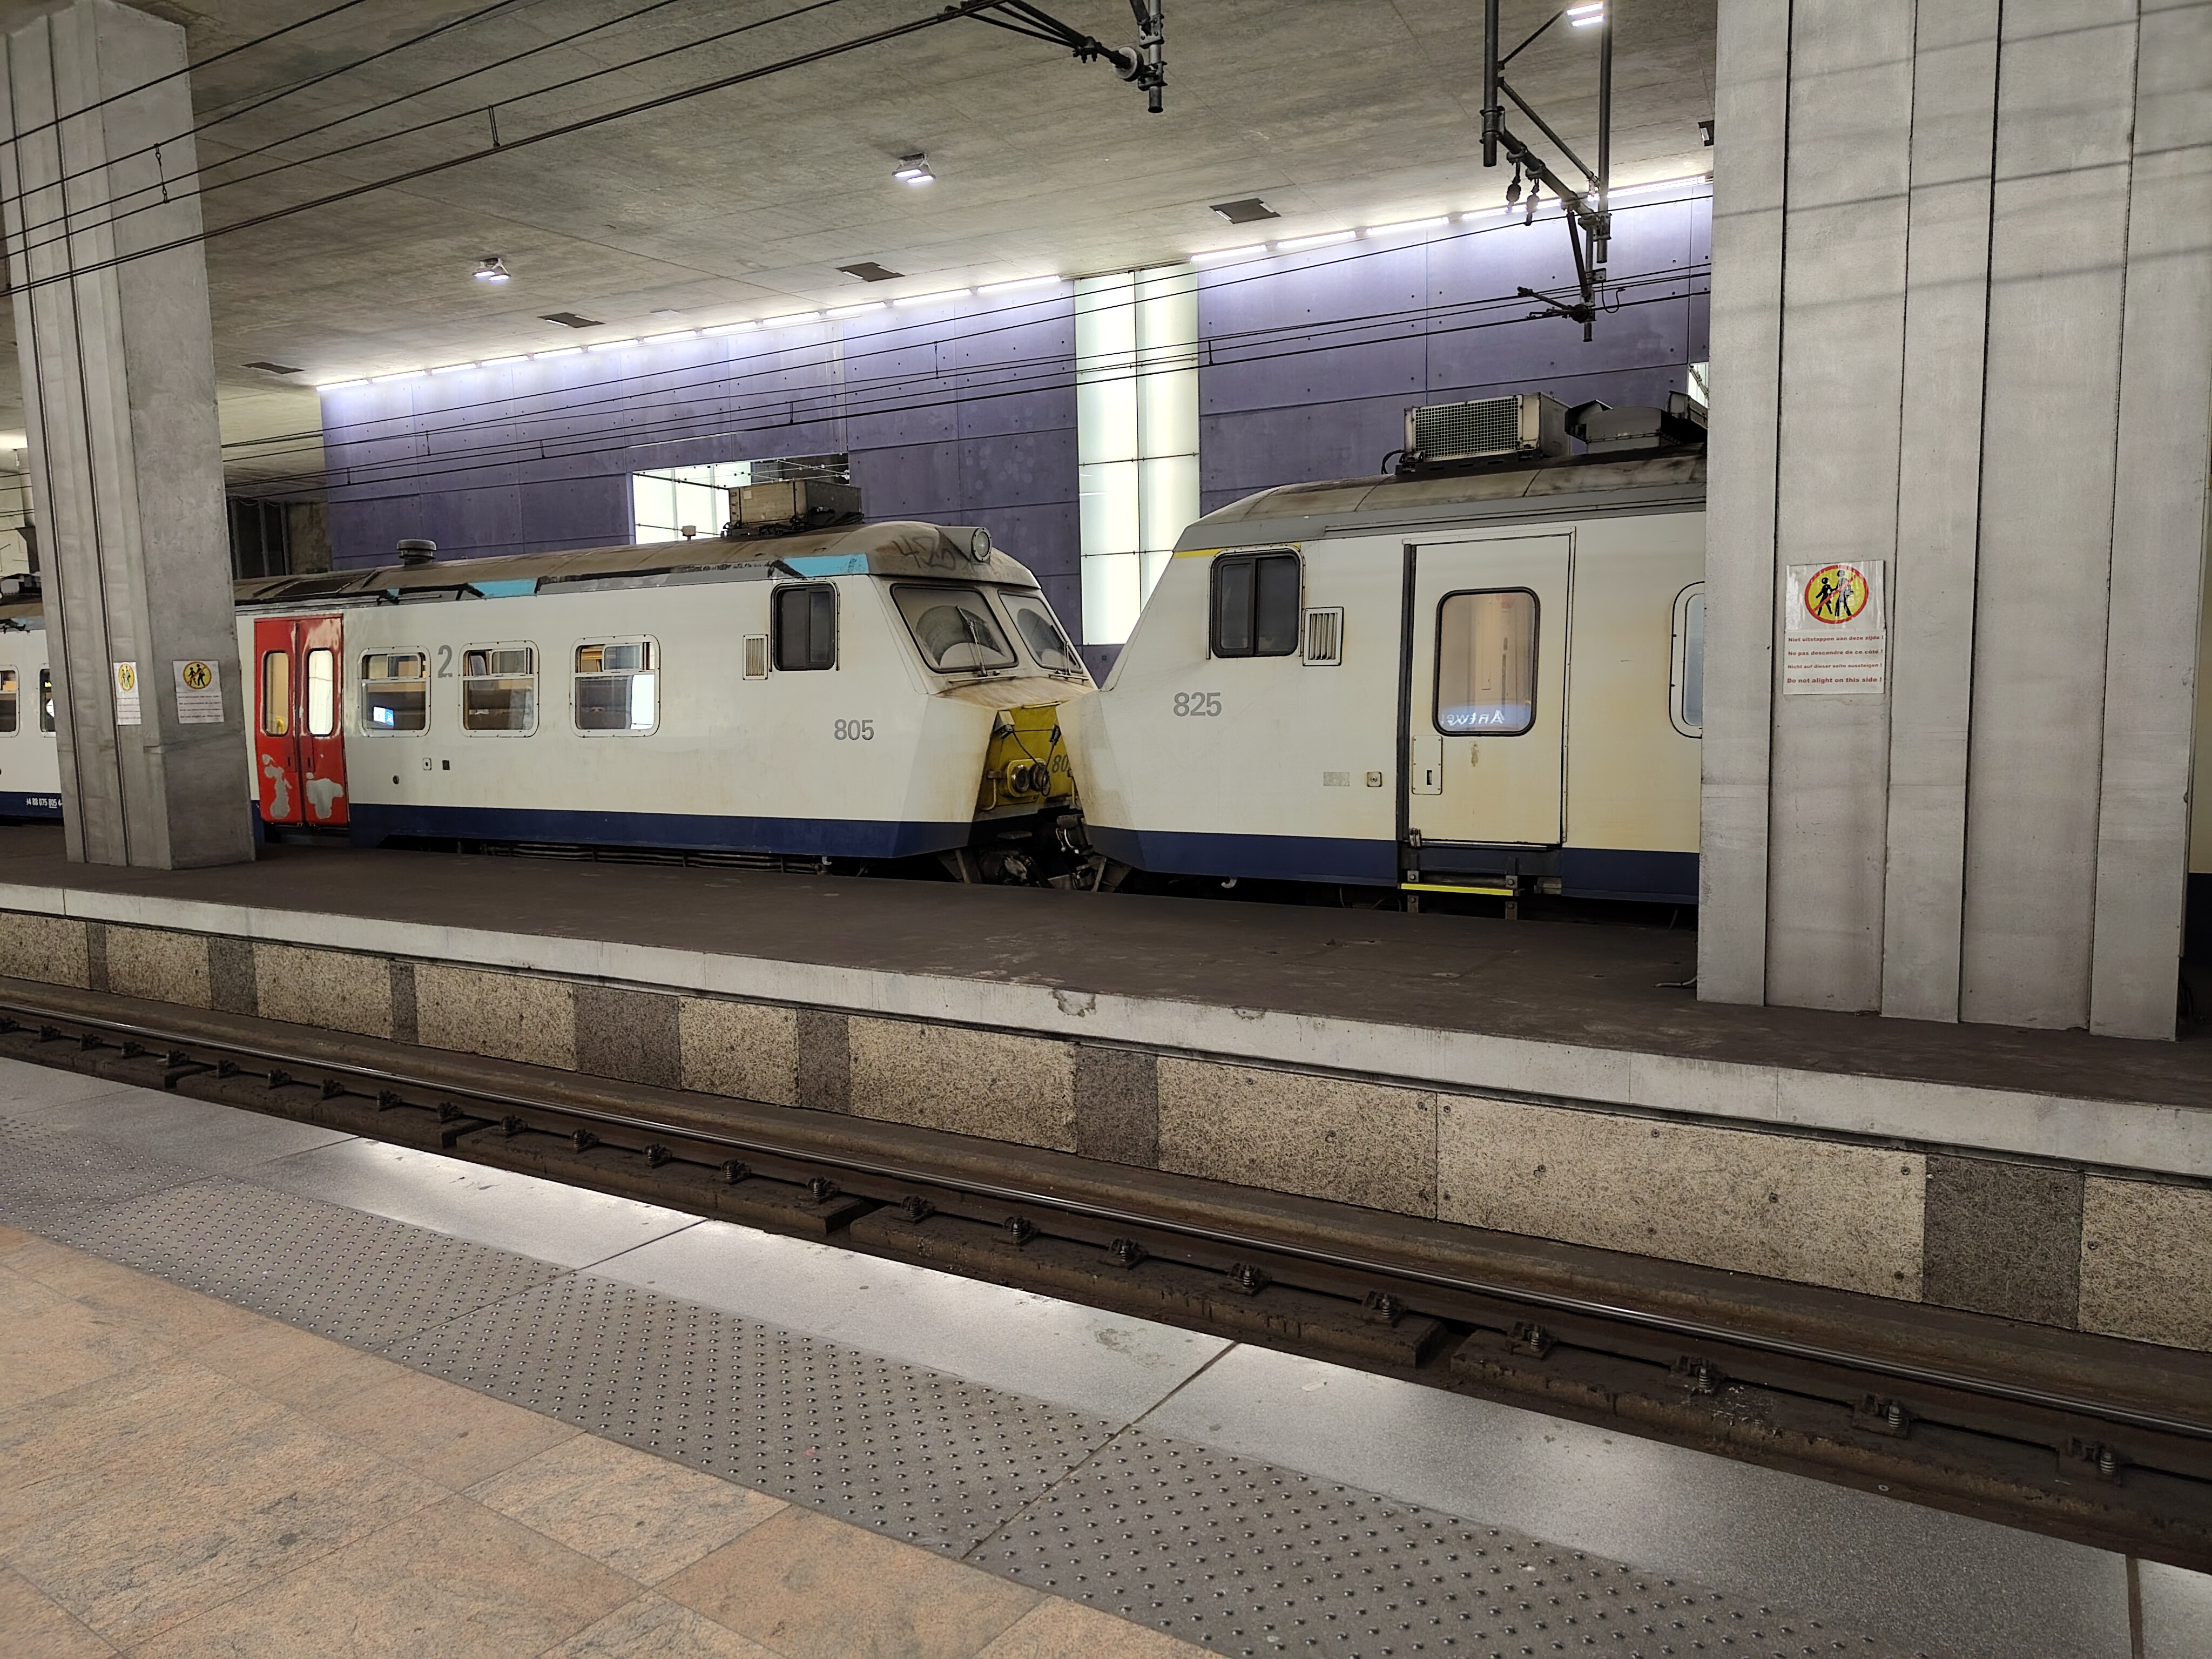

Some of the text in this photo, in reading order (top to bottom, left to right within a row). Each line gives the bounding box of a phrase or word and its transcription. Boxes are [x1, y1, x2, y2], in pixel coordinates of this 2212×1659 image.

[437, 644, 453, 678] 2
[1174, 692, 1222, 717] 825
[834, 719, 874, 740] 805
